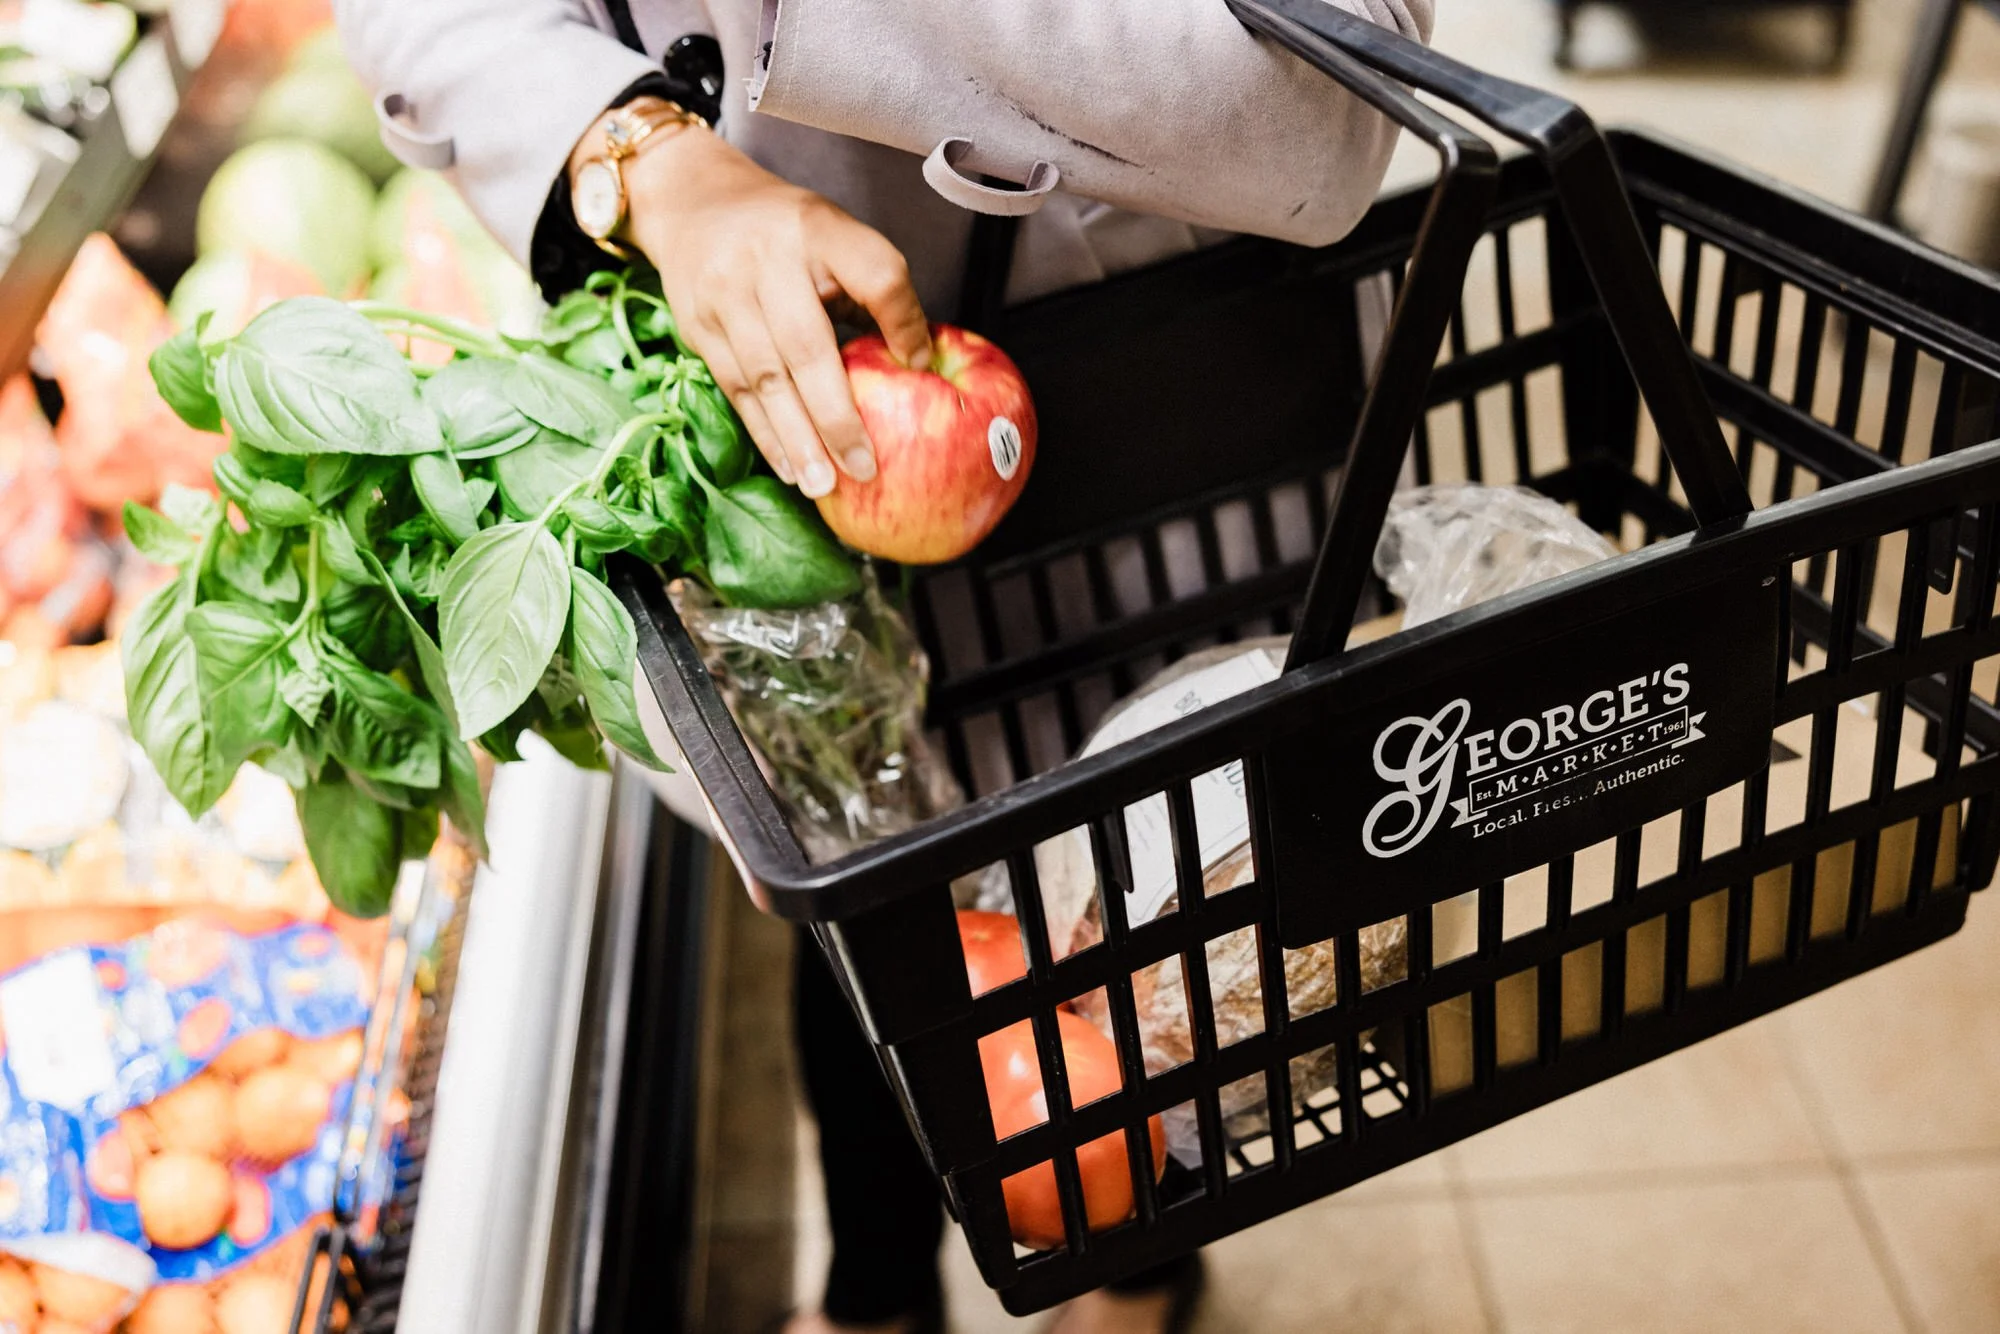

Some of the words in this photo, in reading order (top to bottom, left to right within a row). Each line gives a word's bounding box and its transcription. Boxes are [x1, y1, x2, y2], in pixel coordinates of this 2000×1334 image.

[1362, 663, 1690, 858] GEORGE'S
[1663, 720, 1684, 735] 1961
[1473, 809, 1527, 838] Local.
[1594, 755, 1685, 795] Authentic.
